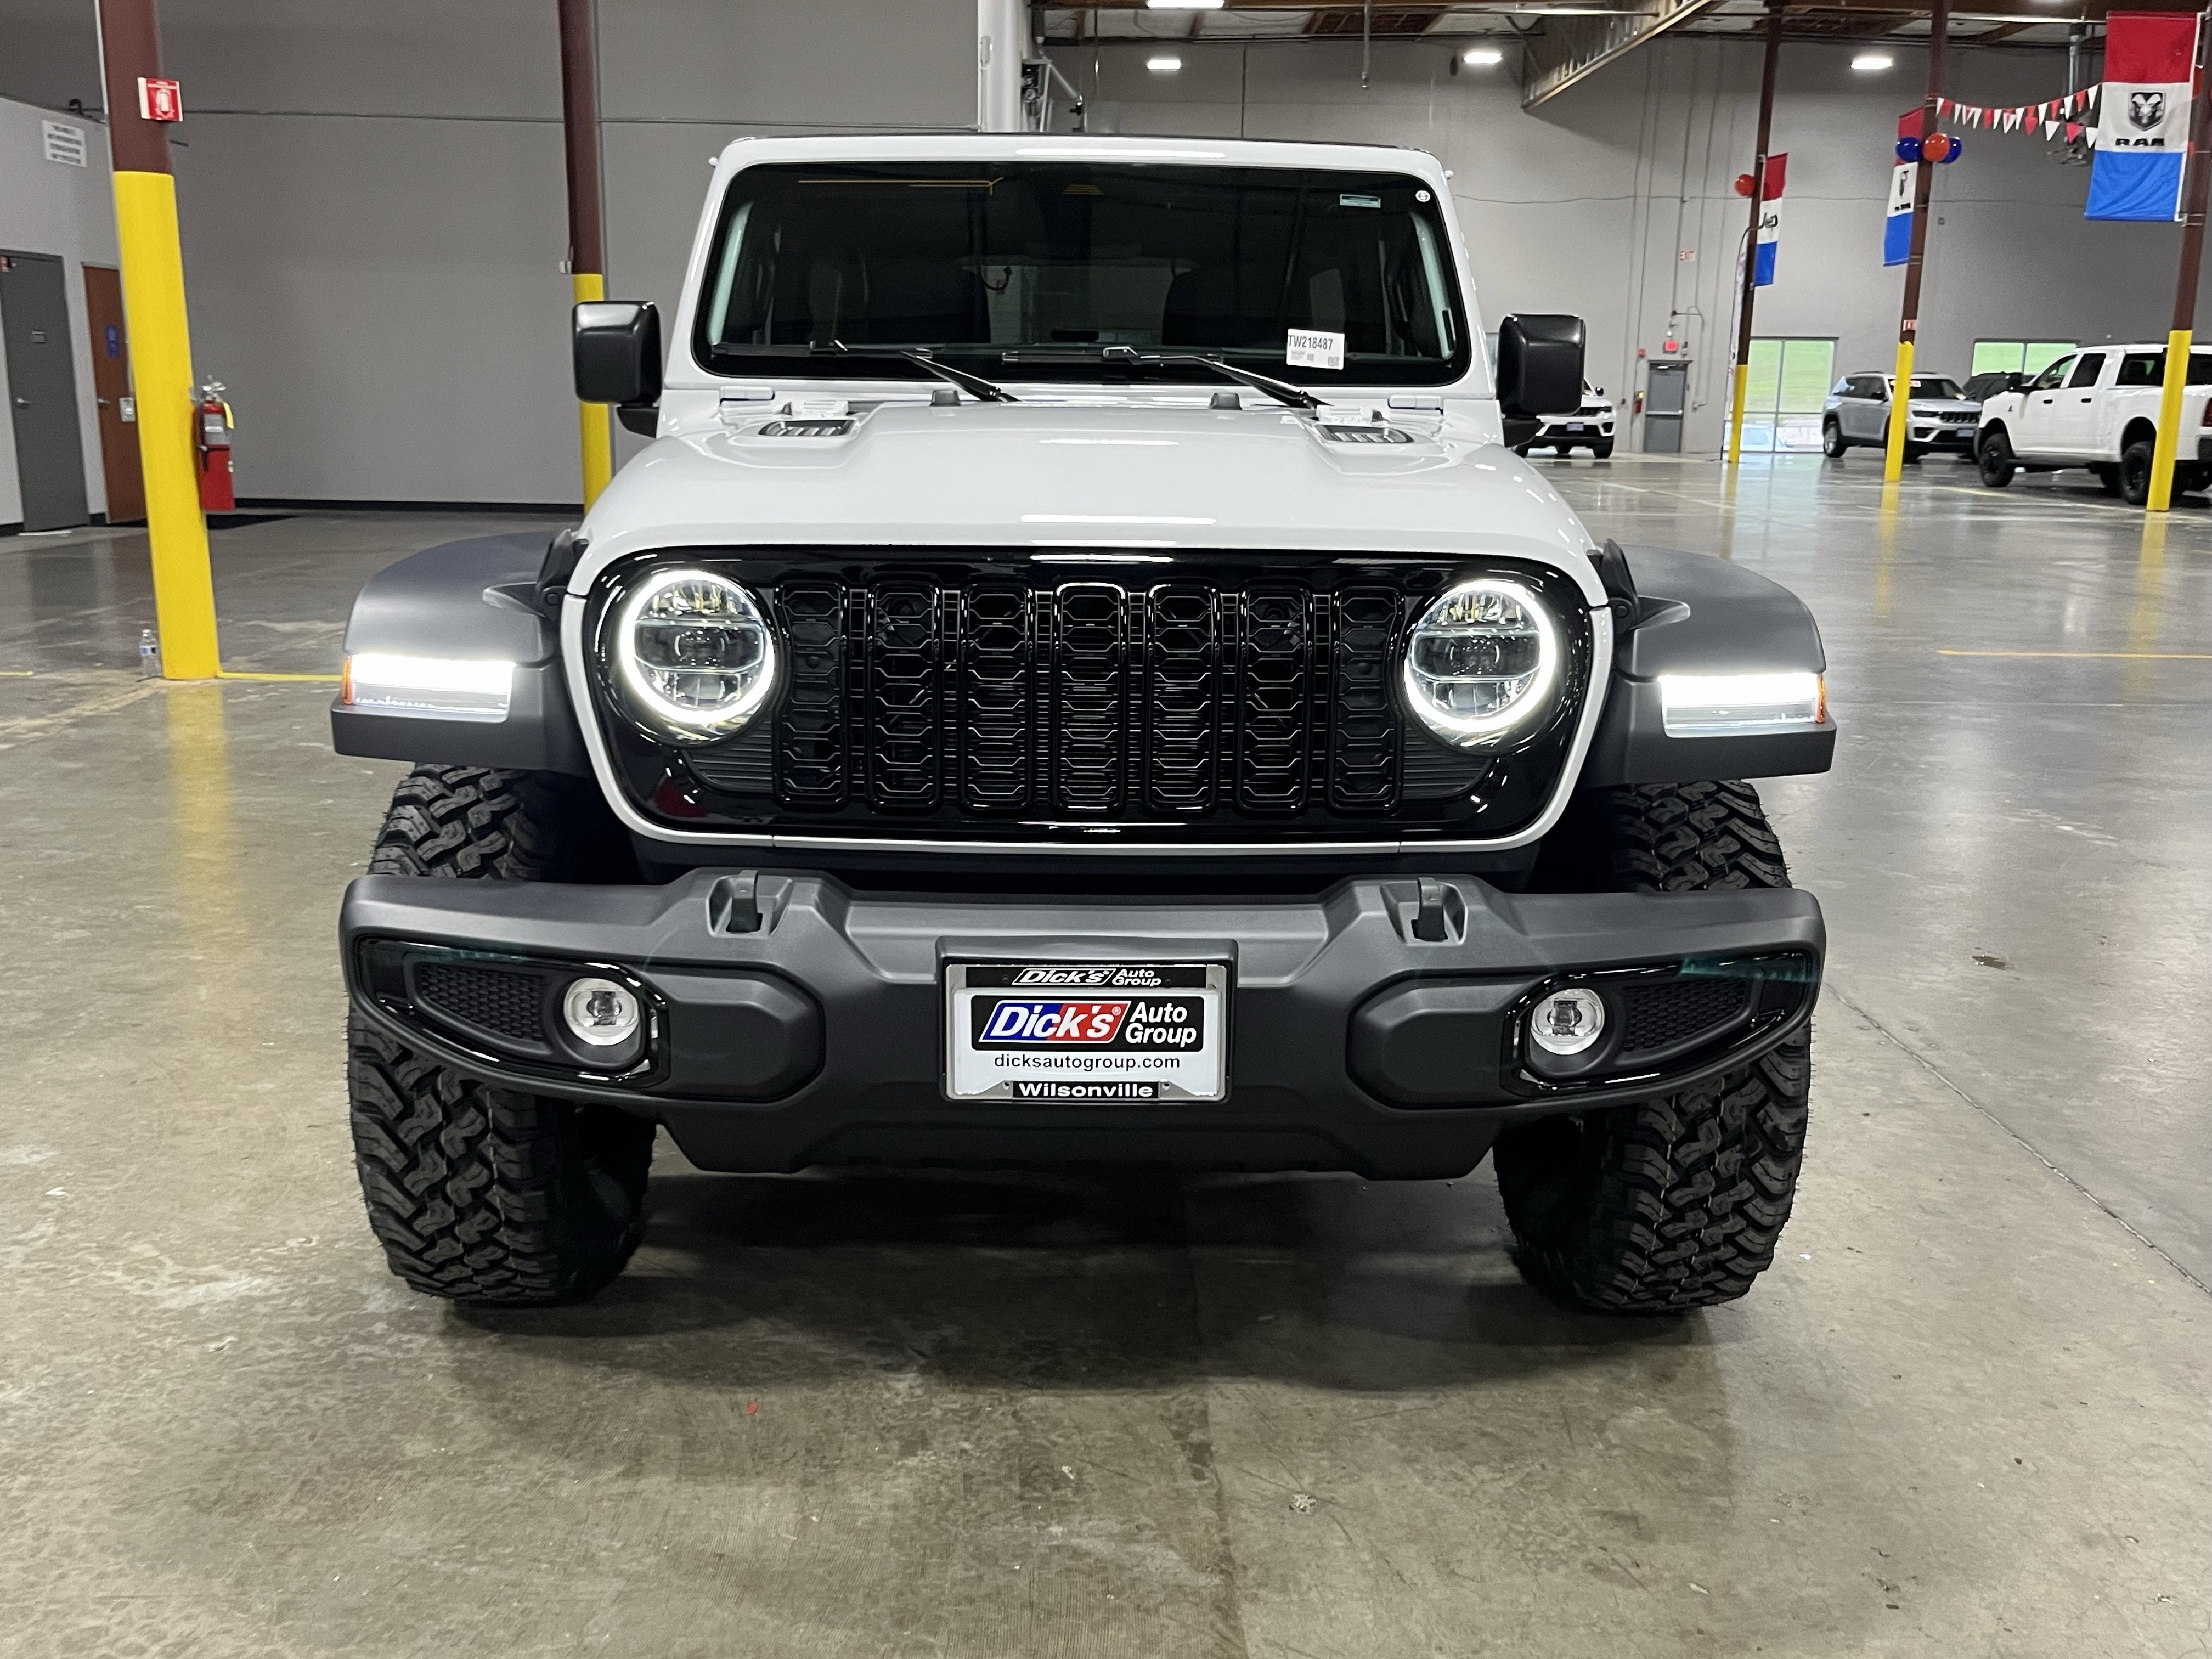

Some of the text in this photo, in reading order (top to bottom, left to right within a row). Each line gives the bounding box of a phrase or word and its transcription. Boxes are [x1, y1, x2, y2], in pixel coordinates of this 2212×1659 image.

[1288, 335, 1333, 351] TW218487
[1019, 970, 1104, 983] Dick's
[1116, 969, 1155, 978] Auto
[1112, 977, 1162, 987] Group
[1128, 1002, 1187, 1023] Auto
[990, 1005, 1114, 1038] Dick's
[1125, 1023, 1197, 1048] Group
[994, 1053, 1180, 1072] dicksautogroup.com
[1019, 1083, 1153, 1097] Wilsonville
